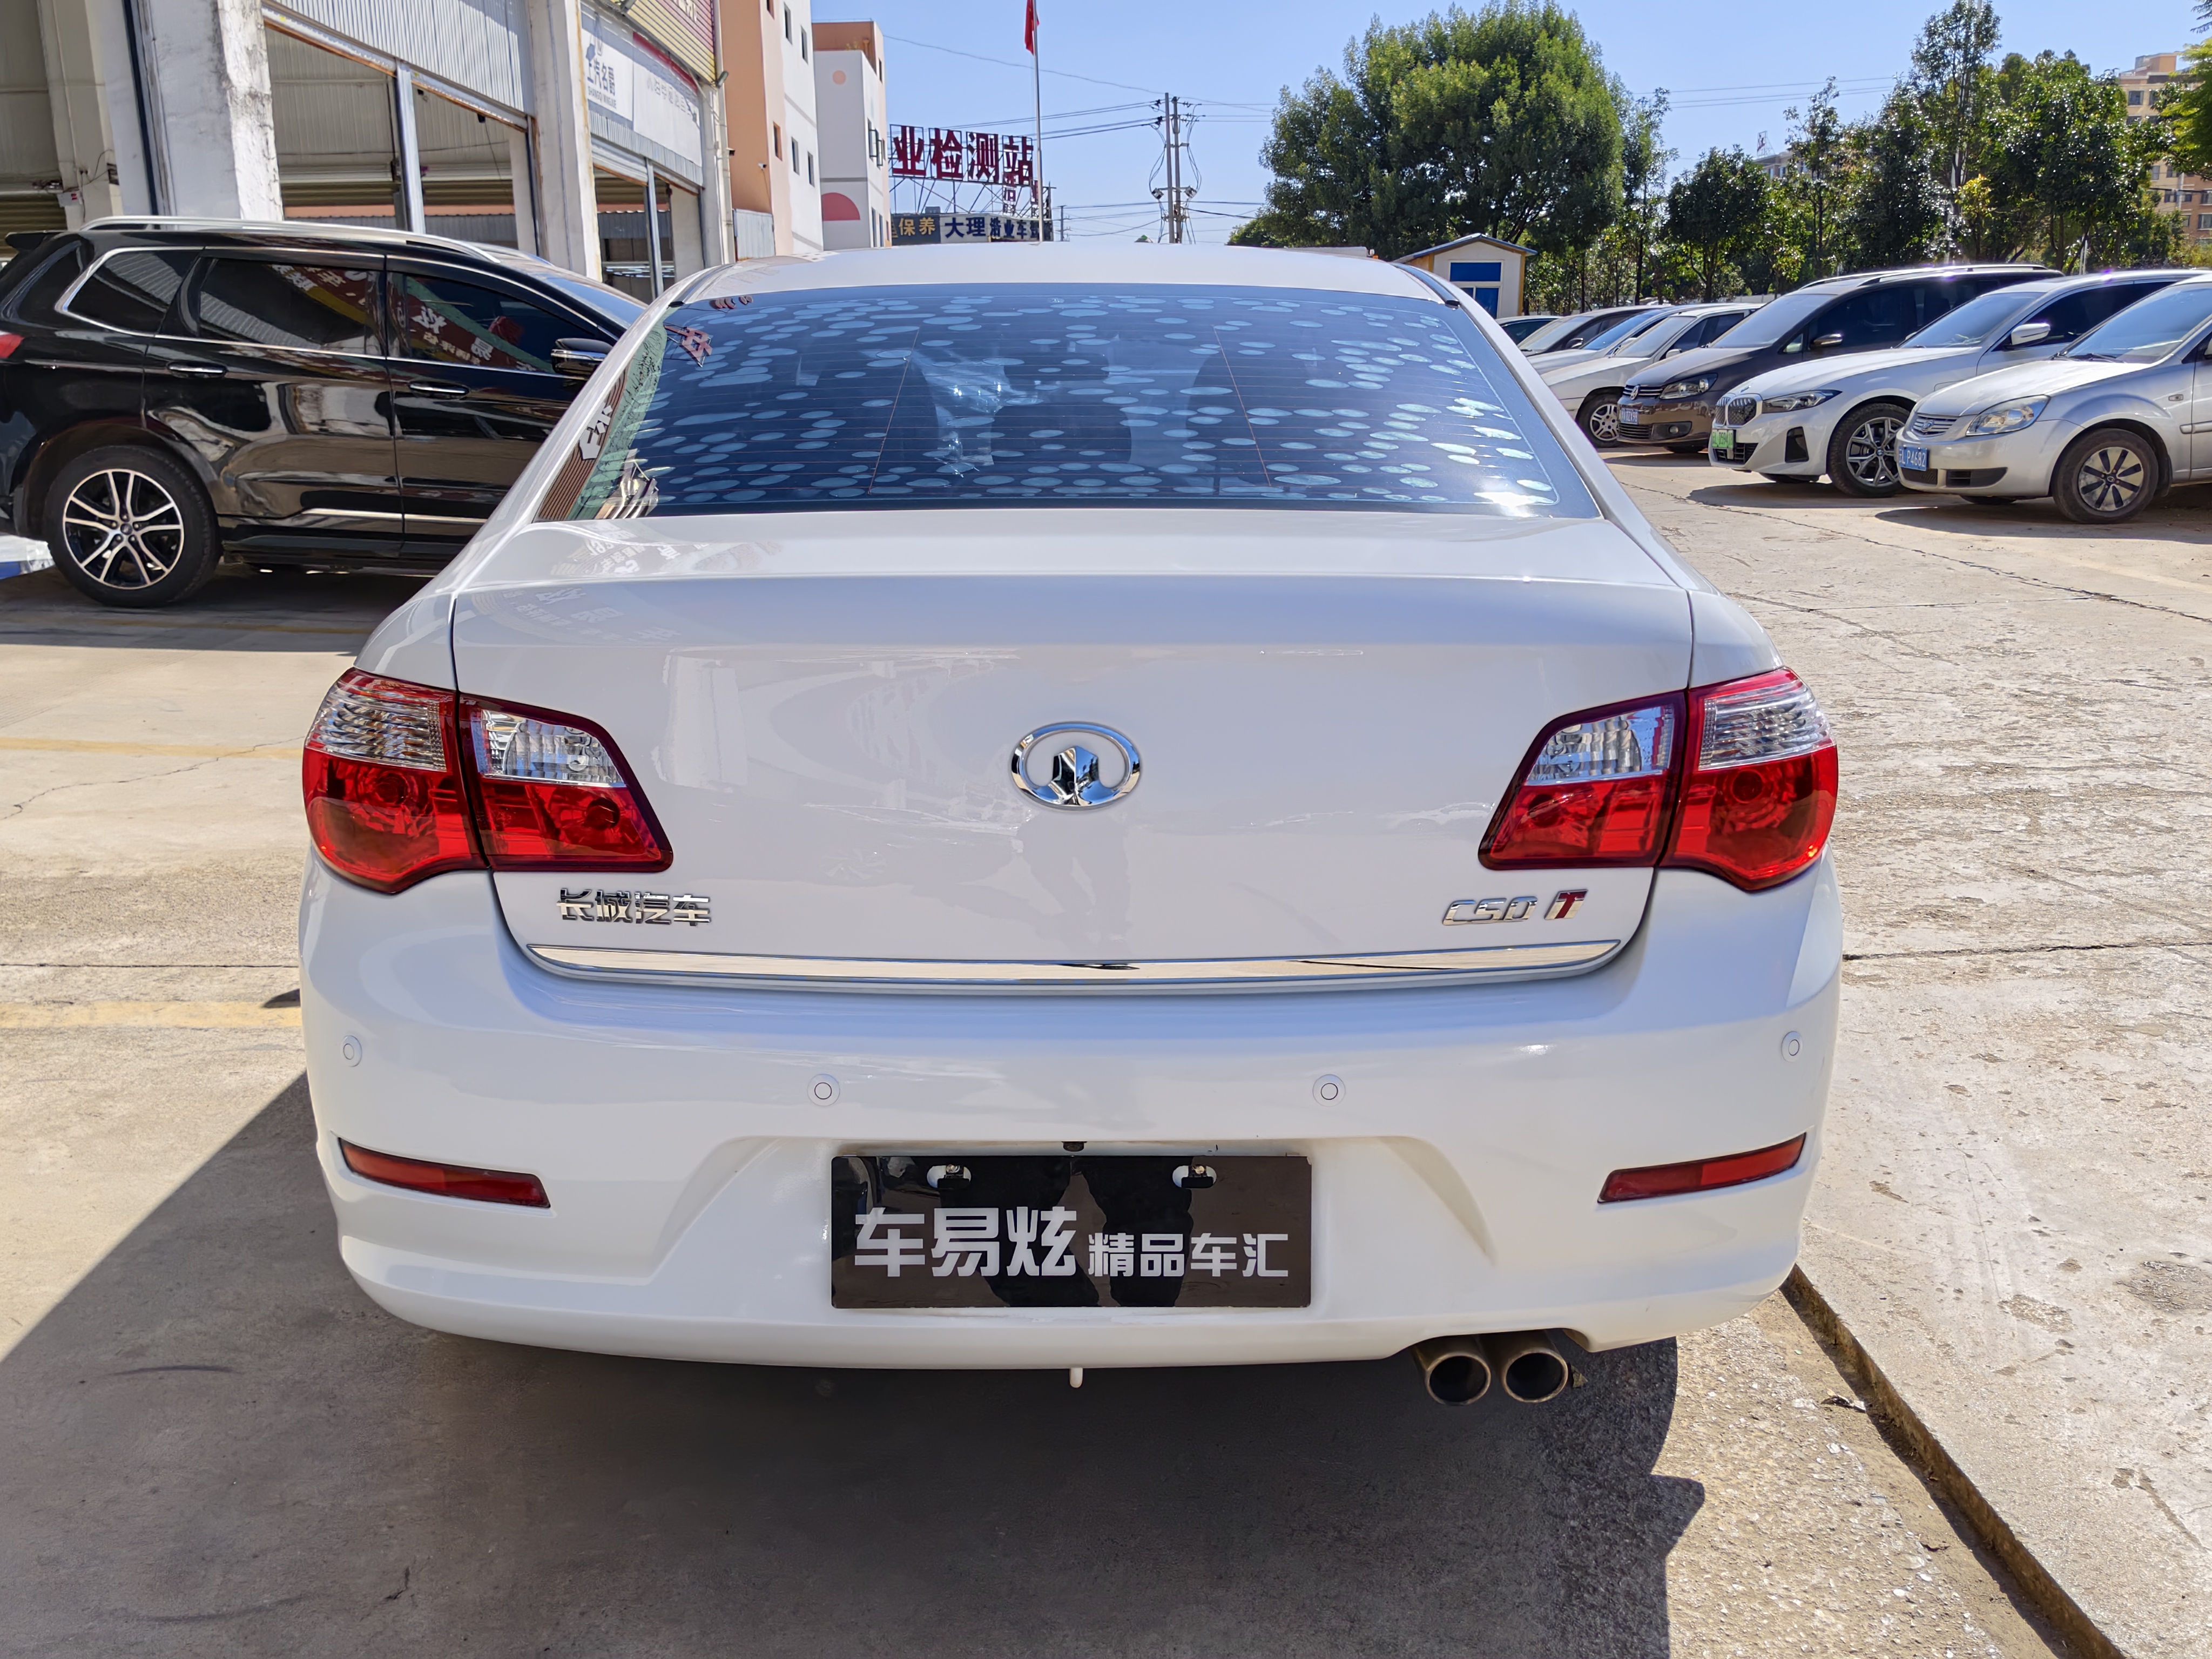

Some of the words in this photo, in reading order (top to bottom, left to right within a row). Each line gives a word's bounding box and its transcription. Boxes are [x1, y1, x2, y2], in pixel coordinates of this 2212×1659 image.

[893, 126, 1034, 185] 业检测站
[556, 888, 711, 927] 长城汽车
[1442, 896, 1537, 926] C50
[855, 1207, 1077, 1277] 车易炫
[1088, 1233, 1289, 1277] 精品车汇
